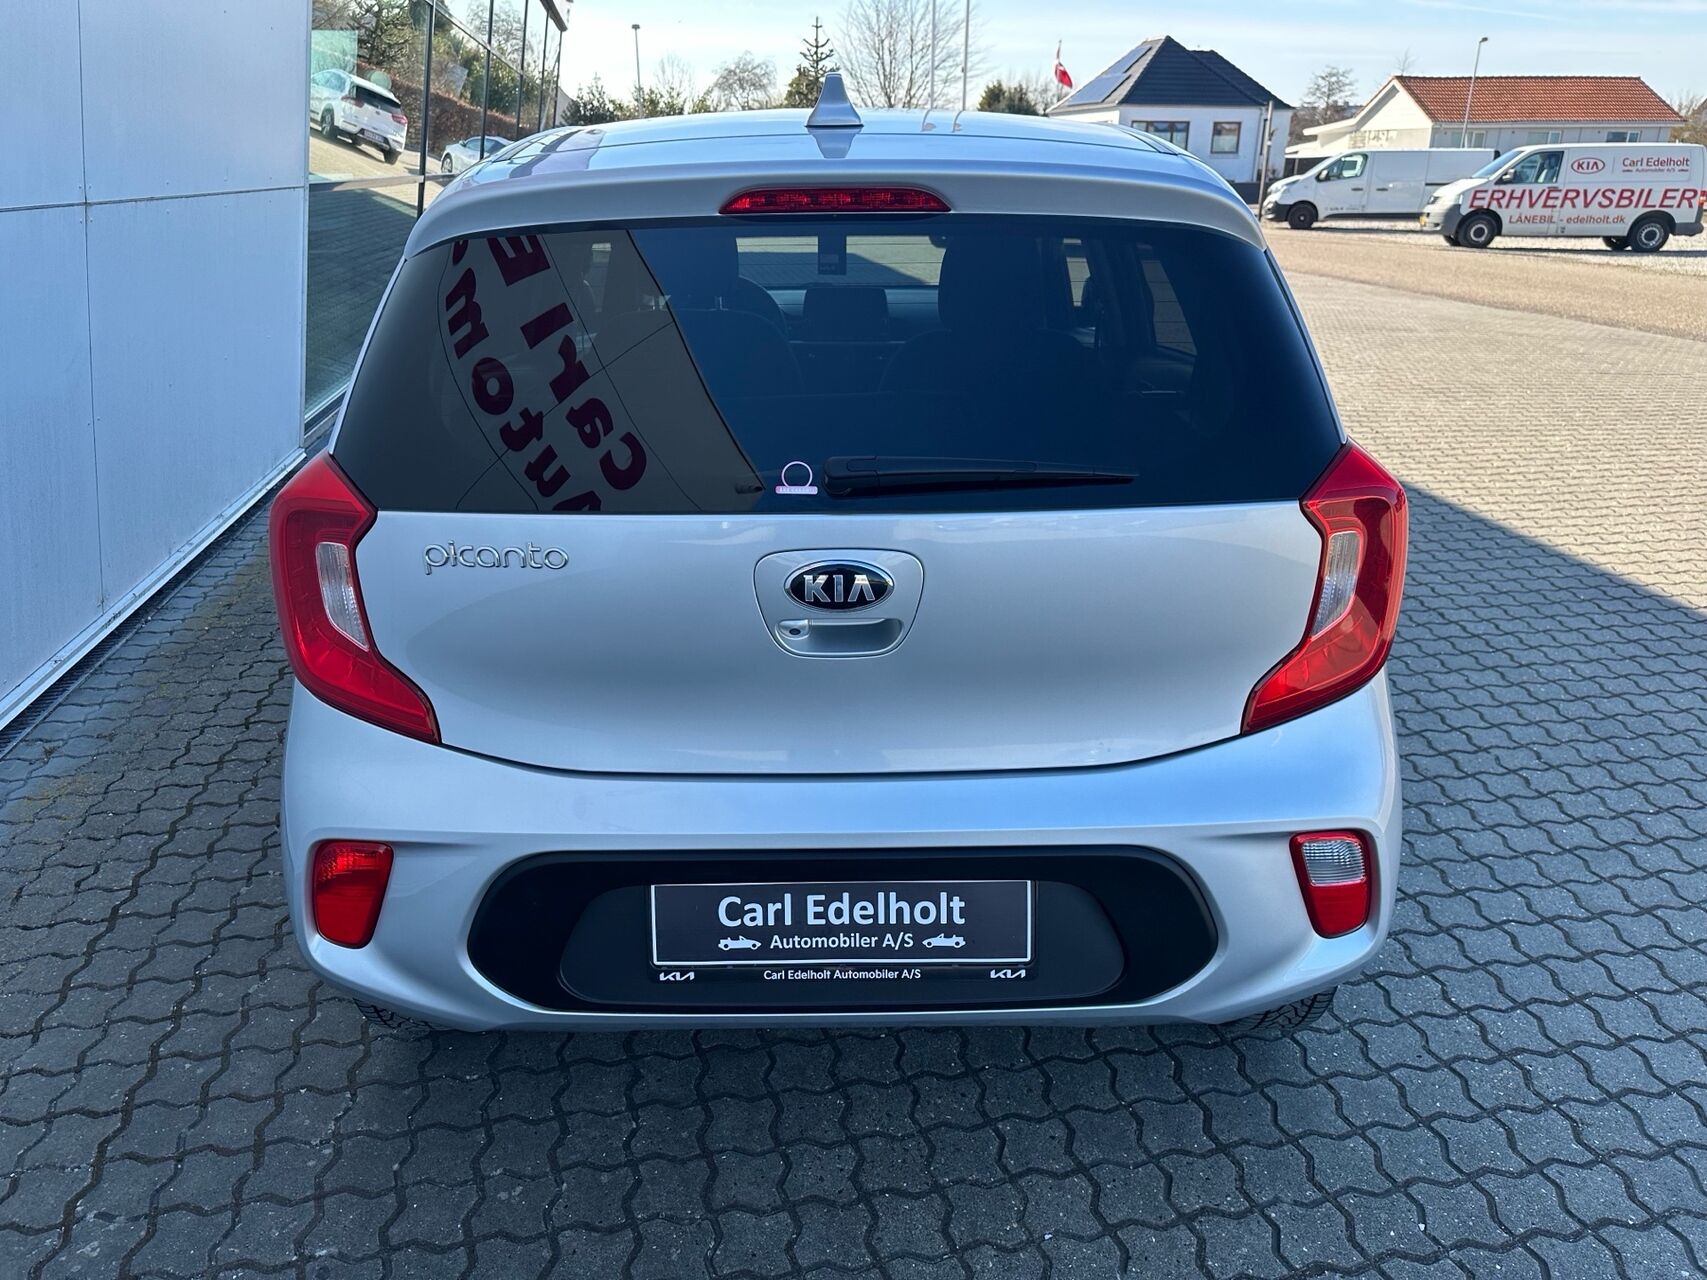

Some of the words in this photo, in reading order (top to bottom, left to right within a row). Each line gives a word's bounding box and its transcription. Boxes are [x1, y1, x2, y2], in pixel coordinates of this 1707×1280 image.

[1576, 161, 1599, 171] KIA
[1622, 157, 1644, 167] Carl
[1646, 157, 1690, 167] Edelholt
[1468, 187, 1699, 209] ERHVERVSBILER
[1508, 213, 1556, 224] LÅNEBIL
[1566, 214, 1626, 225] edelholt.dk
[424, 539, 569, 576] picanto
[803, 574, 876, 602] KIA
[717, 892, 793, 928] Carl
[806, 891, 966, 926] Edelholt
[769, 932, 879, 950] Automobiler
[882, 931, 914, 951] A/S
[763, 970, 786, 981] Carl
[787, 969, 832, 981] Edelholt
[833, 968, 900, 981] Automobiler
[901, 968, 922, 981] A/S
